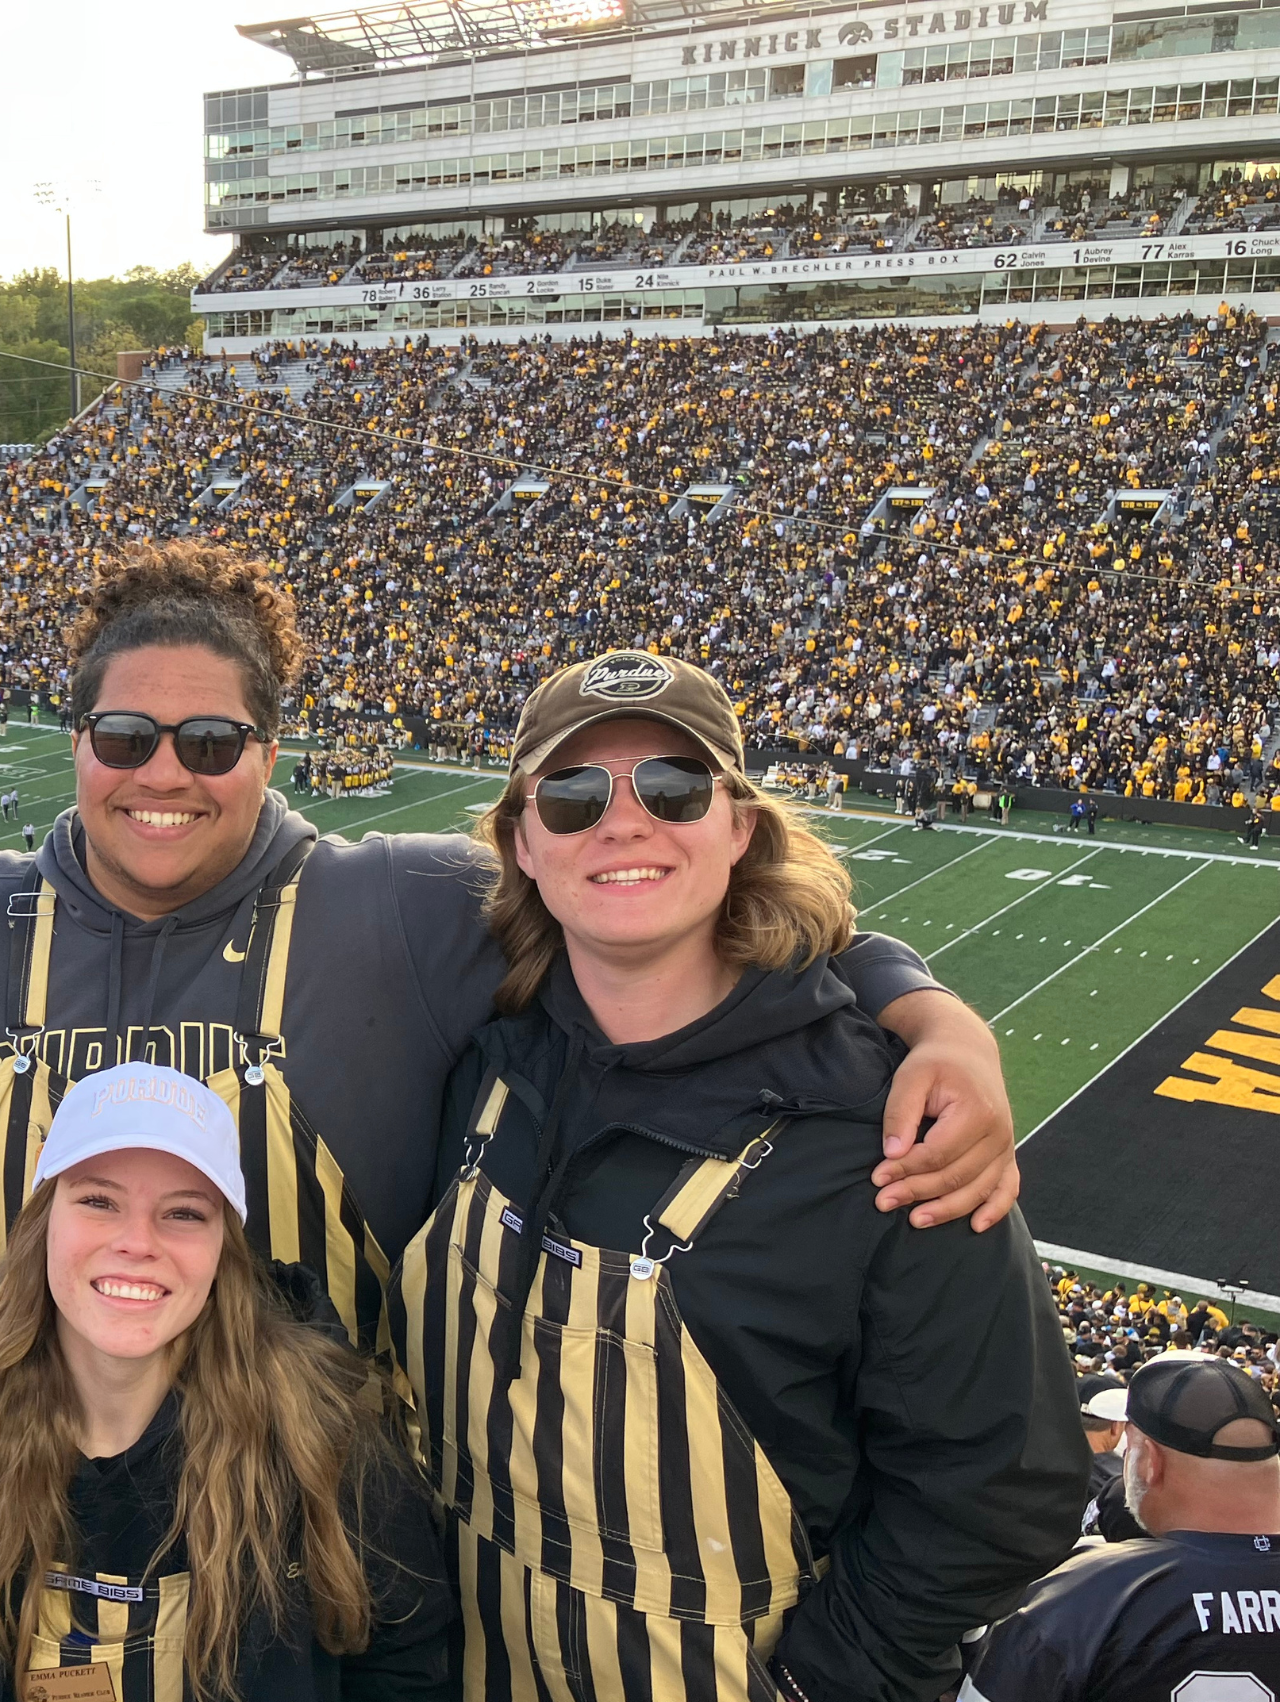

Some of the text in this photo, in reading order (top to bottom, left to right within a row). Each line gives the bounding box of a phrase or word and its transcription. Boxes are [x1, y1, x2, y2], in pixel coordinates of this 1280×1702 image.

[681, 1, 1048, 65] KINNICK STADIUM
[1169, 242, 1187, 250] Alex
[1224, 240, 1247, 256] 16
[1251, 238, 1280, 247] Chuck
[1021, 251, 1046, 259] Calvin
[1073, 249, 1080, 264] 1
[1084, 247, 1113, 257] Aubrey
[1141, 244, 1165, 260] 77
[1167, 251, 1195, 259] Karras
[1250, 246, 1273, 256] Long
[994, 253, 1018, 268] 62
[1020, 259, 1044, 267] Jones
[1083, 254, 1110, 263] Devine
[709, 267, 745, 278] PAUL
[771, 261, 852, 274] BRECHLER
[864, 257, 915, 269] PRESS
[928, 255, 960, 265] BOX
[527, 281, 535, 294] 2
[578, 278, 593, 291] 15
[635, 275, 654, 288] 24
[362, 290, 376, 302] 78
[413, 287, 430, 299] 36
[470, 284, 486, 297] 25
[586, 663, 665, 686] Purdue
[91, 1074, 209, 1134] PURDUE
[542, 1237, 577, 1261] BIBS
[45, 1575, 140, 1600] GAME BIBS
[30, 1667, 96, 1682] EMMA PUCKETT
